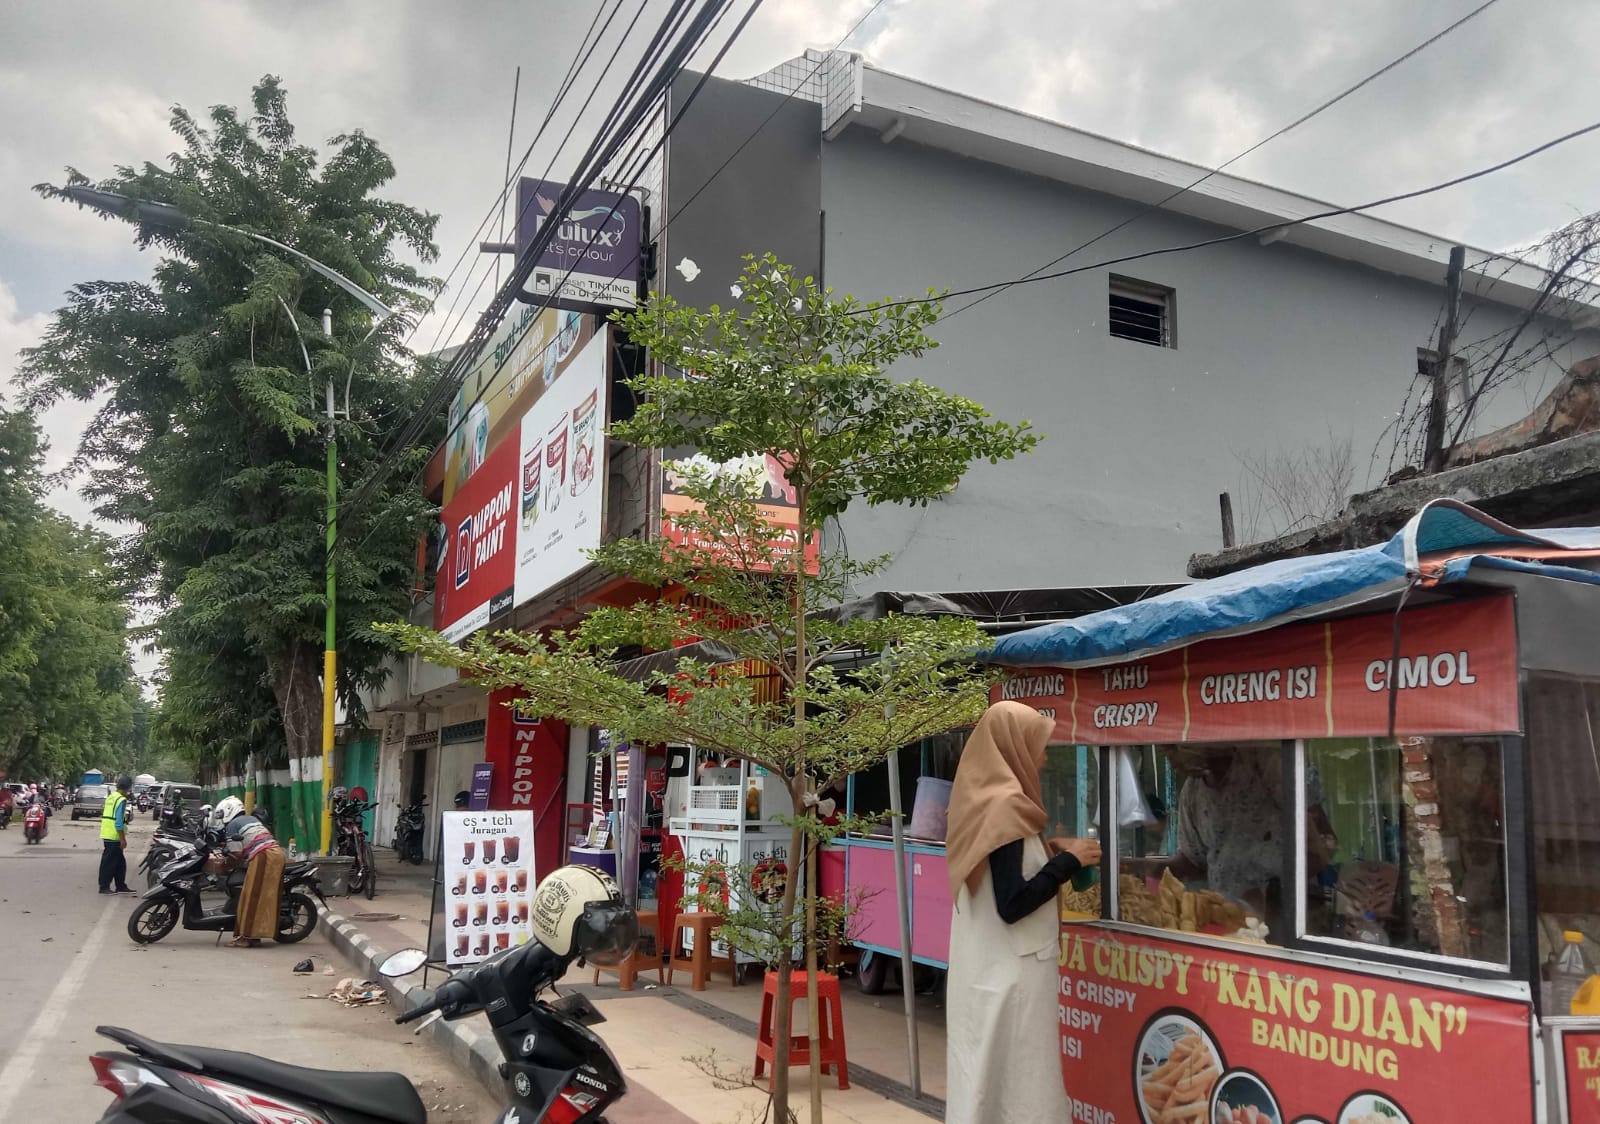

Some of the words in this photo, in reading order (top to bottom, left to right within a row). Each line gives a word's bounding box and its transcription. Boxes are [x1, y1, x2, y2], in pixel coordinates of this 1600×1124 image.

[568, 247, 614, 262] colour
[588, 281, 630, 294] TINTING
[472, 481, 513, 542] NIPPON
[474, 520, 507, 570] PAINT
[1001, 674, 1065, 699] KENTANG
[1102, 665, 1149, 692] TAHU
[1200, 670, 1280, 705] CIRENG
[1286, 666, 1317, 699] ISI
[1093, 702, 1158, 729] CRISPY
[512, 730, 536, 805] NIPPON
[463, 817, 477, 827] es
[492, 813, 513, 826] teh
[470, 827, 507, 835] Juragan
[753, 851, 765, 860] es
[1093, 938, 1194, 995] CRISPY
[1076, 980, 1137, 1013] CRISPY
[1058, 1005, 1102, 1034] RISPY
[1062, 1036, 1082, 1059] ISI
[1251, 1018, 1399, 1081] BANDUNG
[575, 1073, 608, 1091] HONDA
